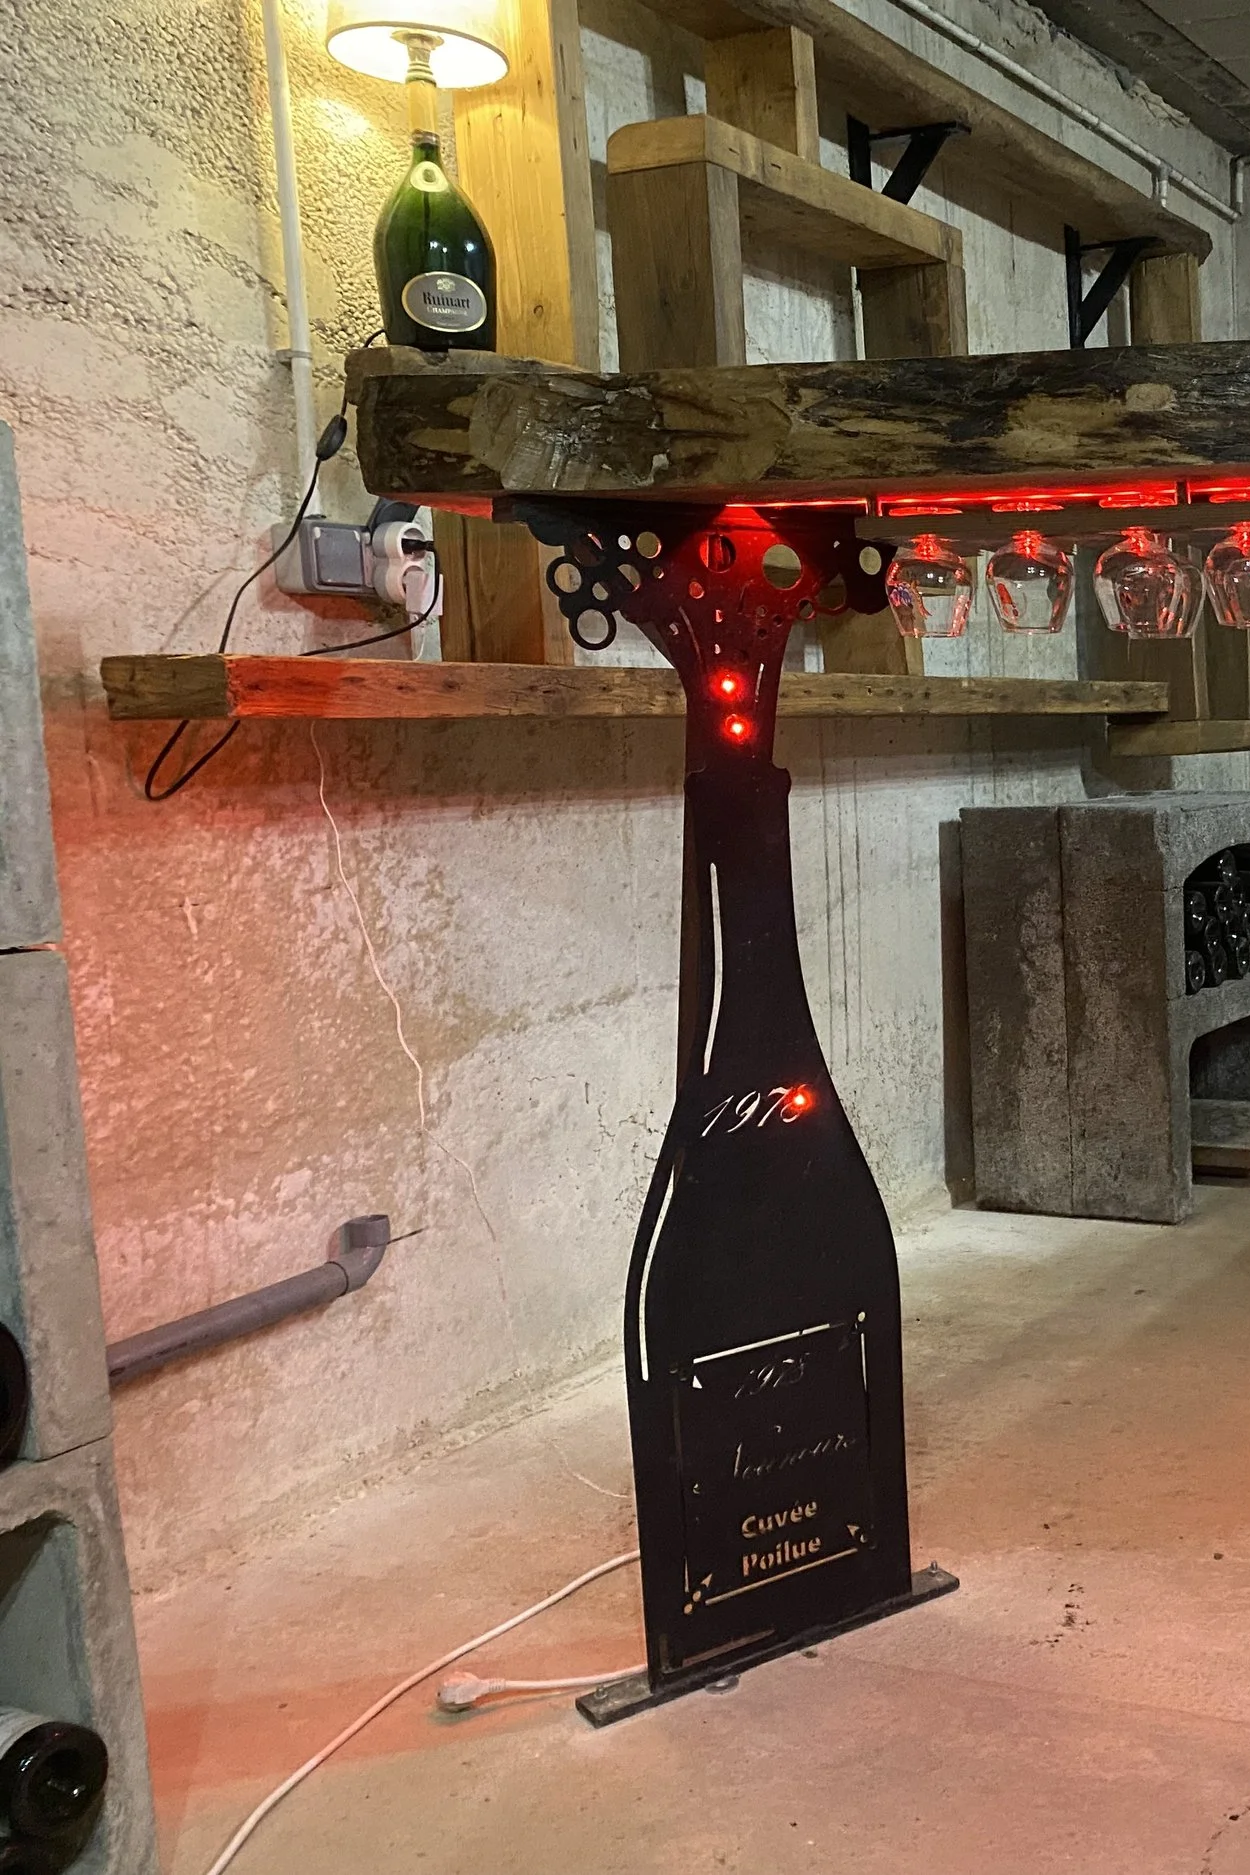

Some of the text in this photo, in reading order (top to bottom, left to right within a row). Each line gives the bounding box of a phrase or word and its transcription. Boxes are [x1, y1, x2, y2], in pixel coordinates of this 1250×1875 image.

[422, 291, 470, 308] Ruinart
[741, 1500, 818, 1538] Cuvée
[742, 1537, 821, 1577] Poilue
